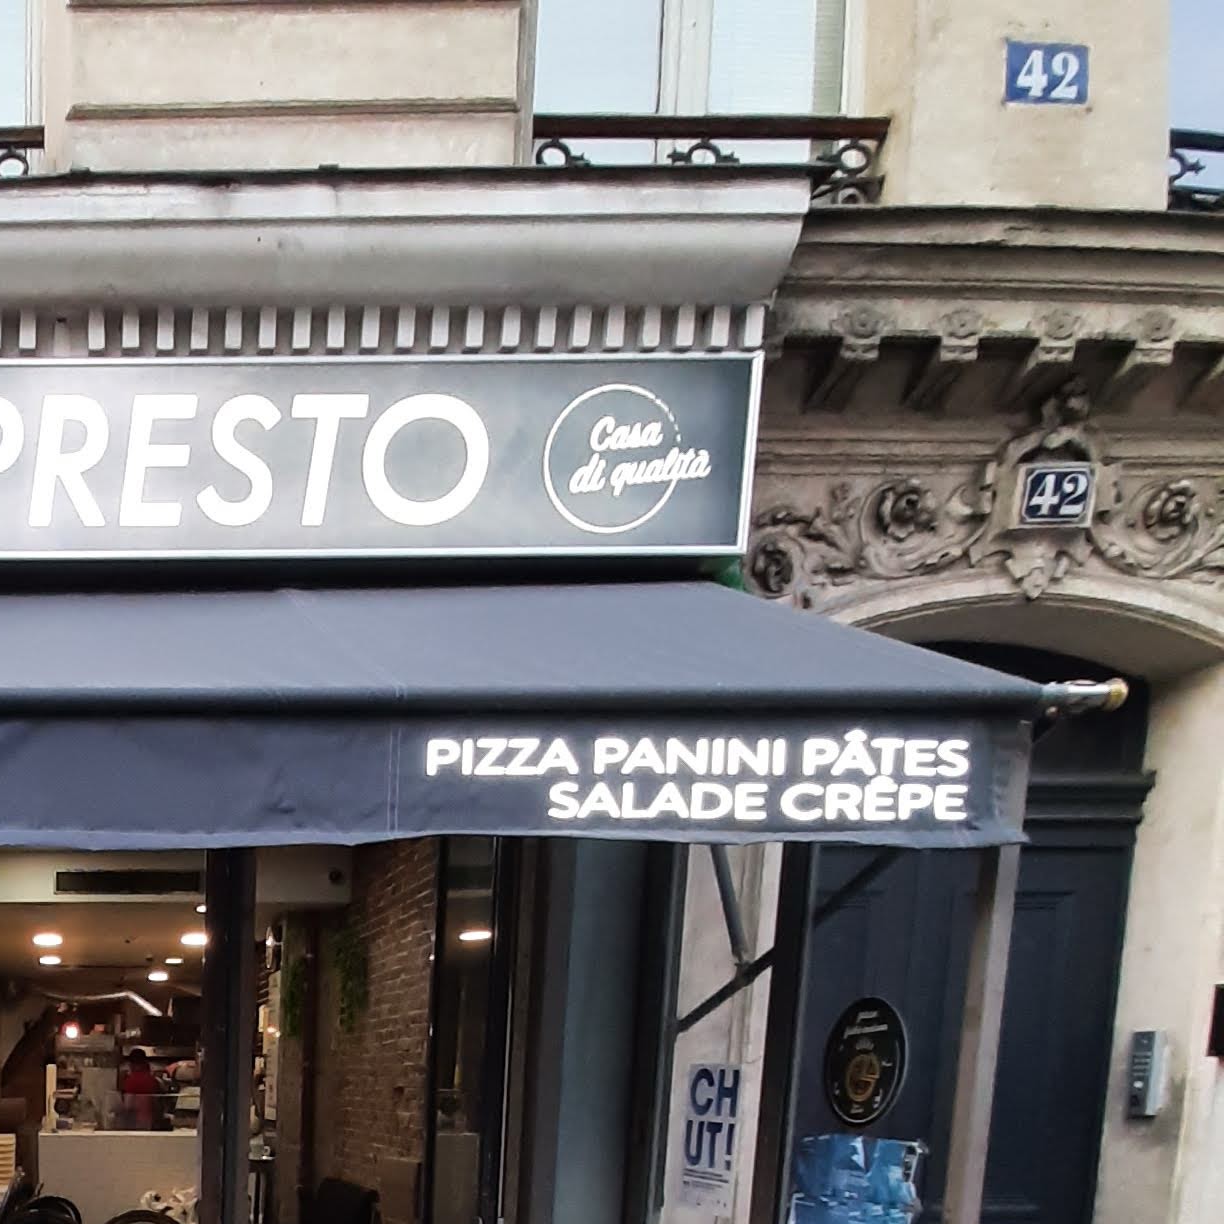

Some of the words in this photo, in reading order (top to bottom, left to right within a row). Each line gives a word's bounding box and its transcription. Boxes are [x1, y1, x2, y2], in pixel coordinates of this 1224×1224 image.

[1016, 49, 1080, 99] 42
[590, 415, 664, 452] Casa
[569, 452, 607, 494] di
[1029, 473, 1088, 516] 42
[426, 738, 578, 776] PIZZA
[593, 737, 786, 776] PANINI
[802, 729, 970, 777] PÂTES
[547, 783, 768, 820] SALADE
[780, 777, 968, 821] CRÊPE
[690, 1068, 740, 1118] CH
[684, 1119, 736, 1171] UT!
